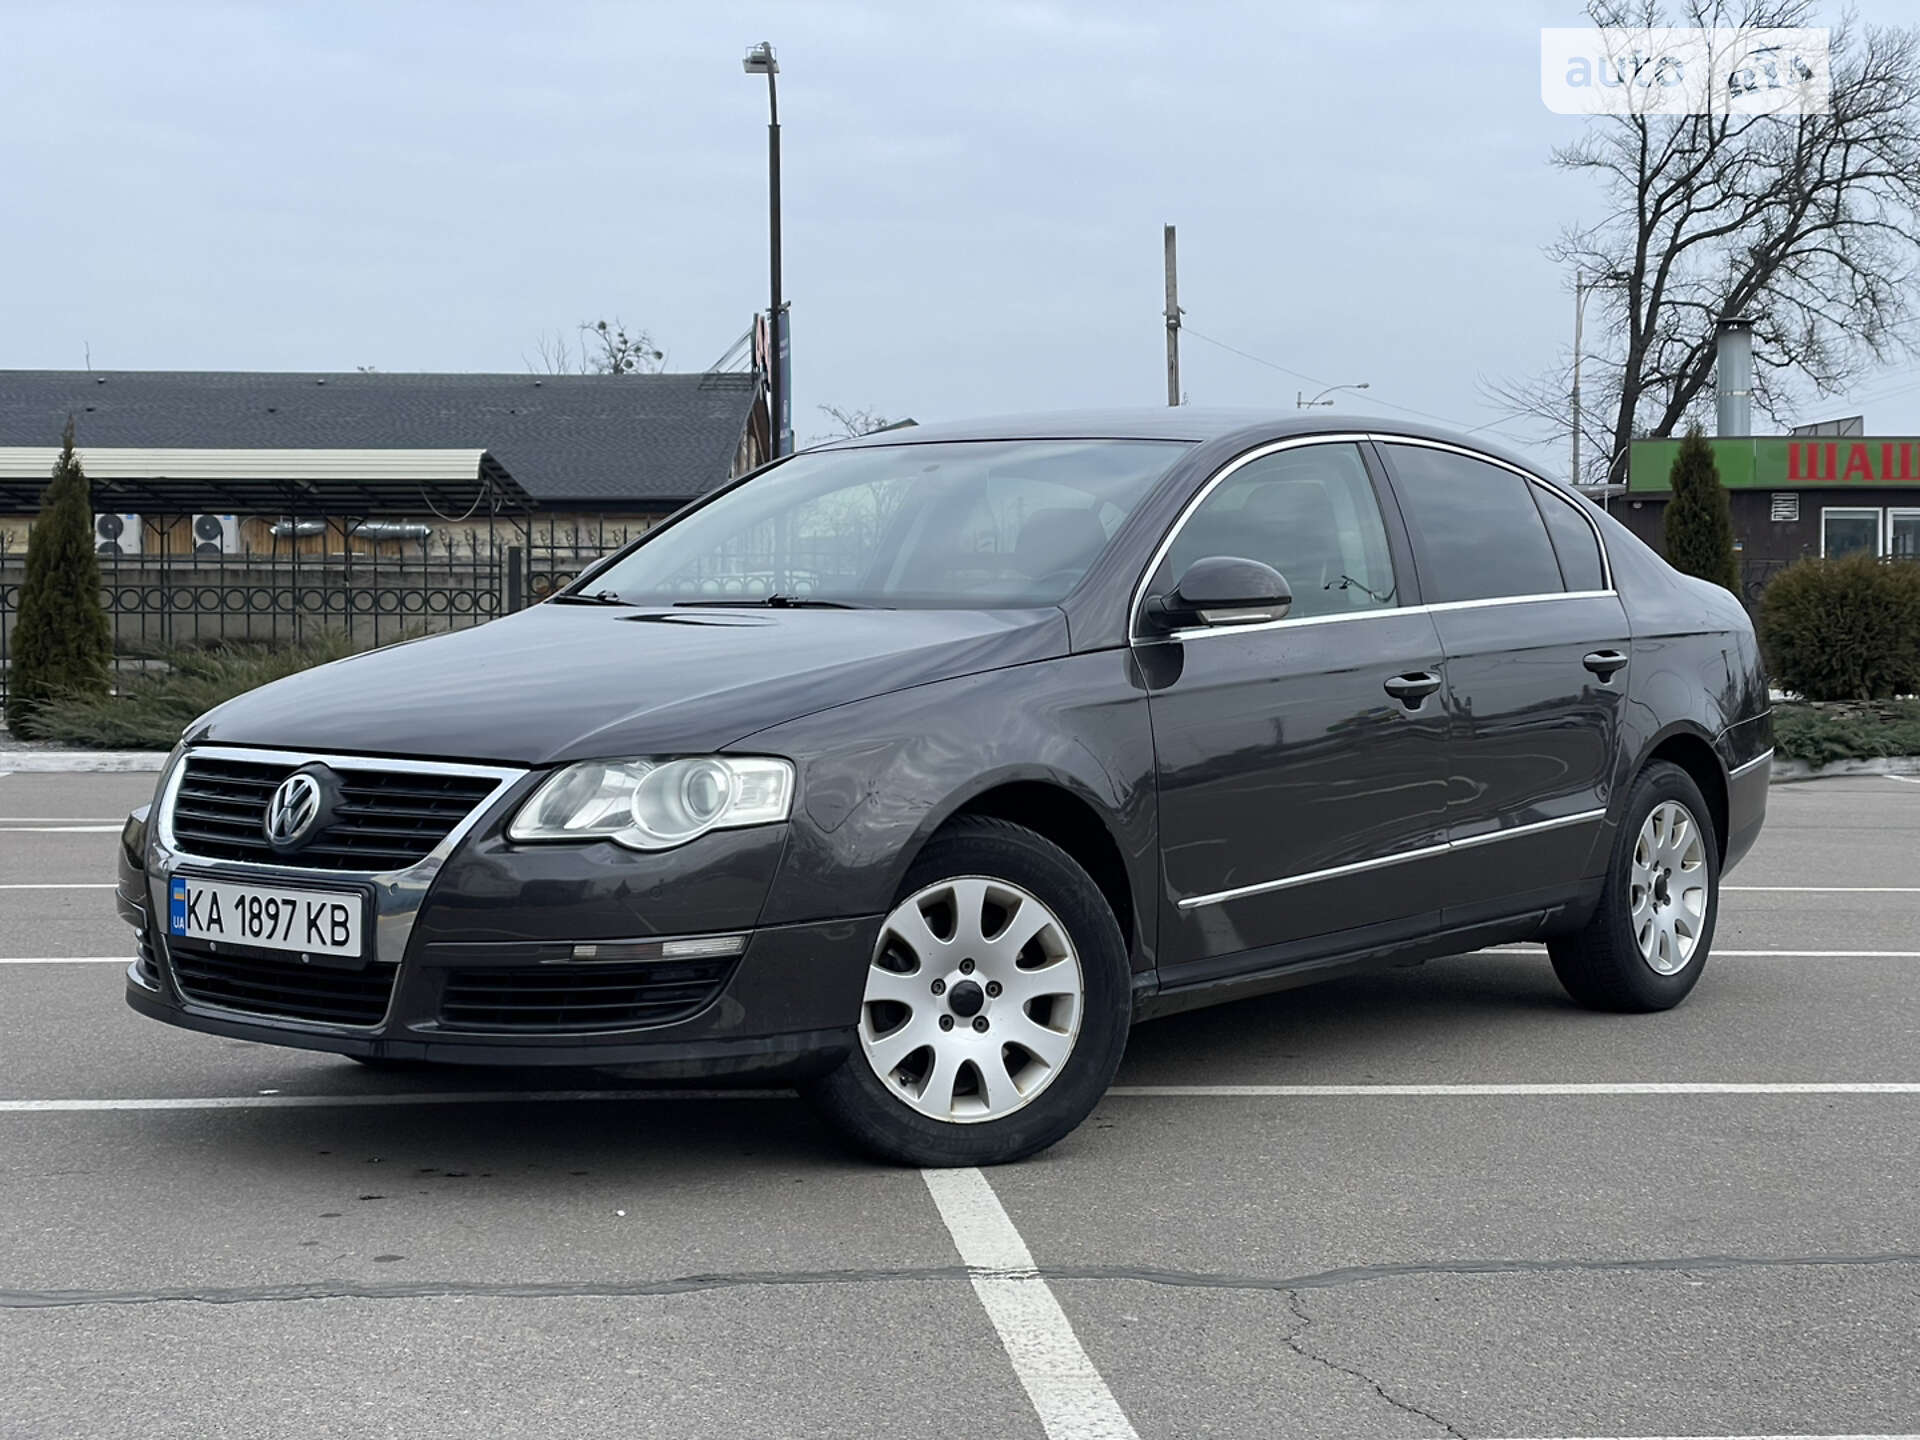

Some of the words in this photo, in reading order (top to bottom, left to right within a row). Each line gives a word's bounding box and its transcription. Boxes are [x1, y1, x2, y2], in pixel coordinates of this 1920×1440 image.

[173, 915, 185, 929] UA
[187, 888, 224, 933] KA
[234, 894, 297, 941] 1897
[306, 901, 350, 947] KB
